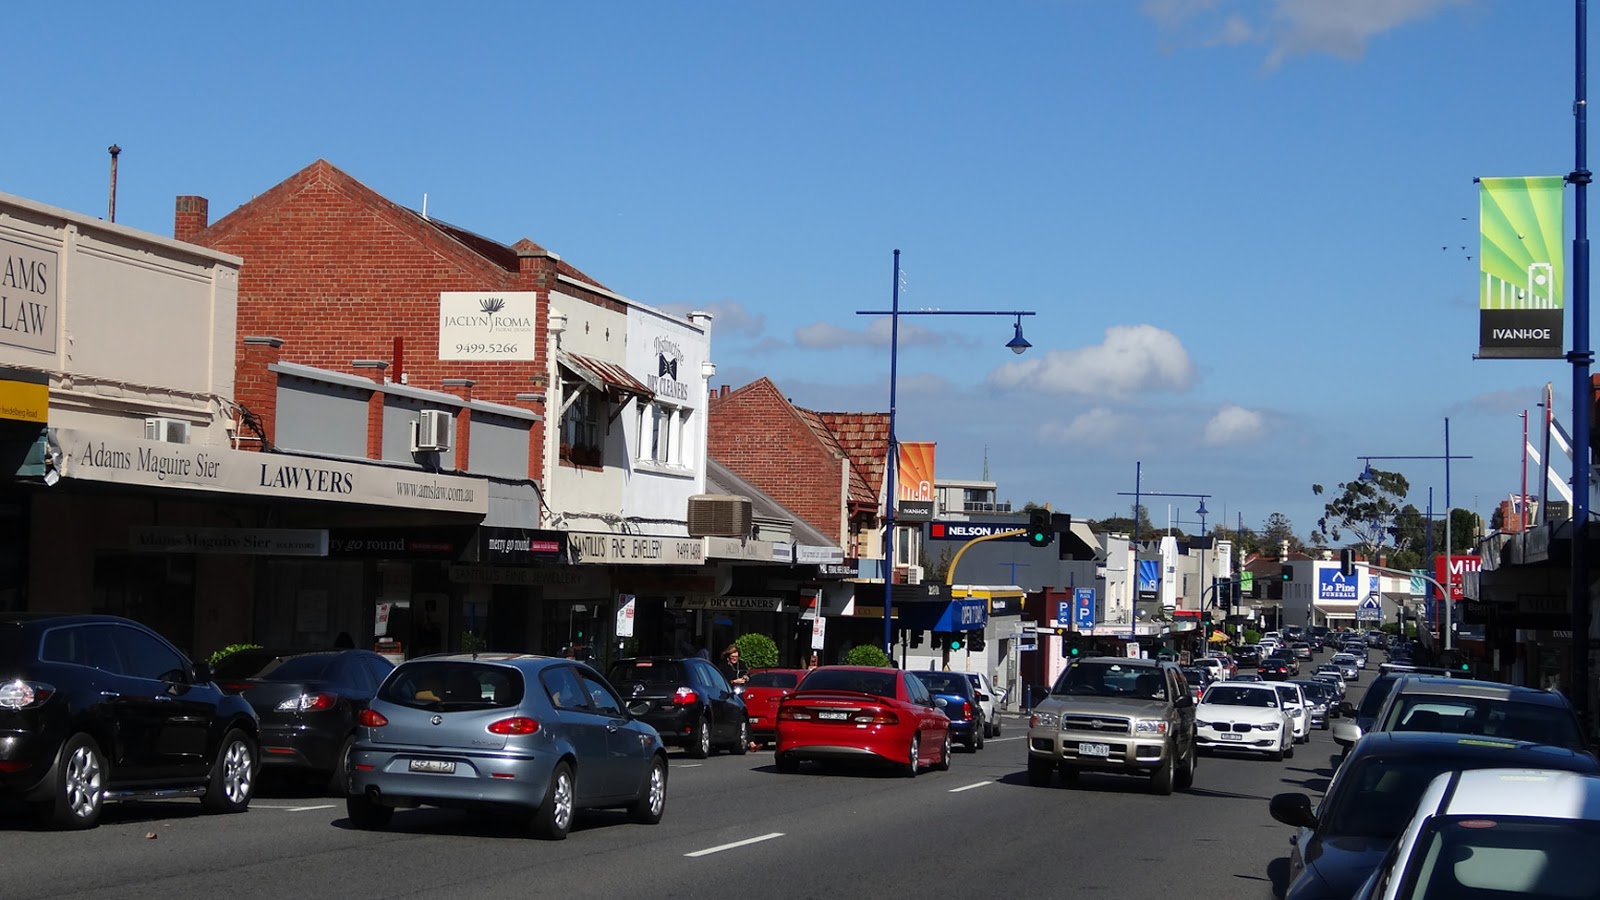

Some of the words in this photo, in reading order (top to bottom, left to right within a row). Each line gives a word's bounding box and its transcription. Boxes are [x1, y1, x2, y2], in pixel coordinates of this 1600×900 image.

[2, 254, 47, 296] AMS
[1, 296, 48, 336] LAW
[445, 316, 488, 328] JACLYN
[495, 316, 531, 327] ROMA
[1493, 329, 1550, 339] IVANHOE
[456, 343, 518, 353] 9499.5266
[660, 377, 688, 401] CLEANERS
[81, 442, 131, 469] Adams
[138, 446, 191, 480] Maguire
[195, 453, 220, 479] Sier
[260, 463, 353, 495] LAWYERS
[396, 480, 474, 503] www.amslaw.com.au
[949, 526, 991, 536] NELSON
[243, 535, 272, 548] Sier
[367, 537, 406, 551] round
[612, 538, 626, 558] FINE
[631, 539, 663, 559] JEWELLERY
[1321, 583, 1334, 592] Le
[1335, 583, 1356, 592] Pine
[710, 598, 728, 608] DRY
[729, 598, 774, 609] CLEANERS
[1060, 602, 1068, 612] P
[1079, 608, 1090, 620] P
